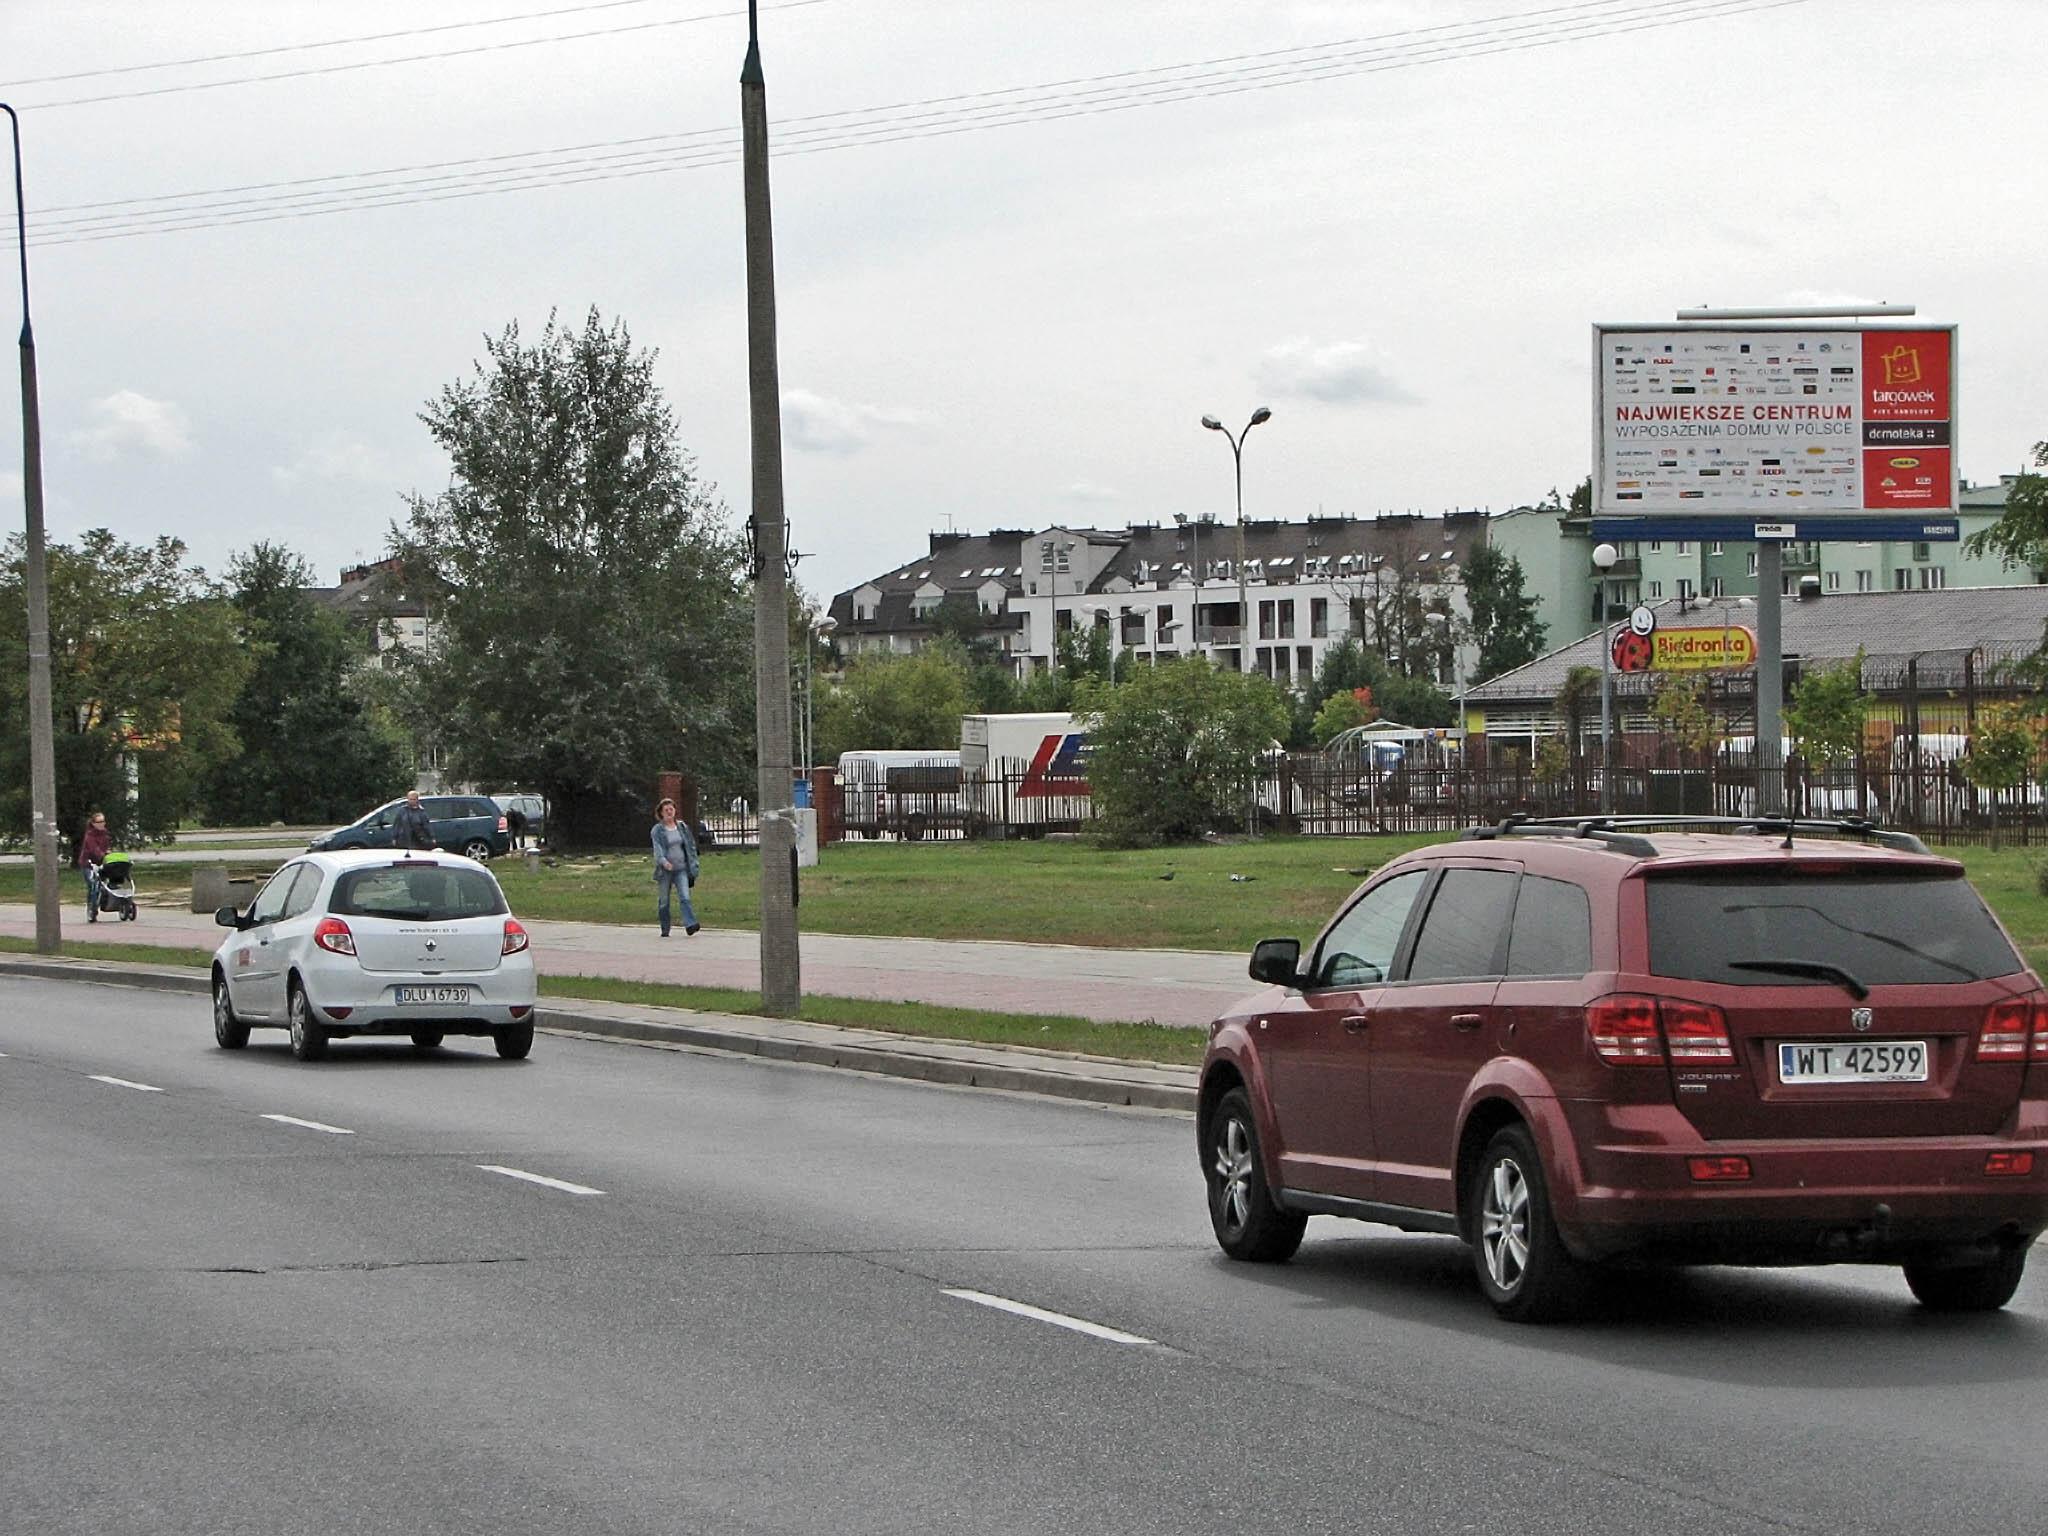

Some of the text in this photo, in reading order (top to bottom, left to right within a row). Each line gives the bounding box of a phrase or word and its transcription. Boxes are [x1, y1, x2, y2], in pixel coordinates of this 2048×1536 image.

[1873, 389, 1935, 406] targówek
[1616, 405, 1852, 423] NAJWIĘKSZE CENTRUM
[1616, 423, 1853, 438] WYPOSAŻENIA DOMU W POLSCE
[1869, 428, 1923, 439] domoteka
[403, 989, 427, 1001] DLU
[431, 989, 467, 1001] 16739
[1797, 1045, 1922, 1074] WT 42599
[1677, 1073, 1742, 1081] JOURNEY
